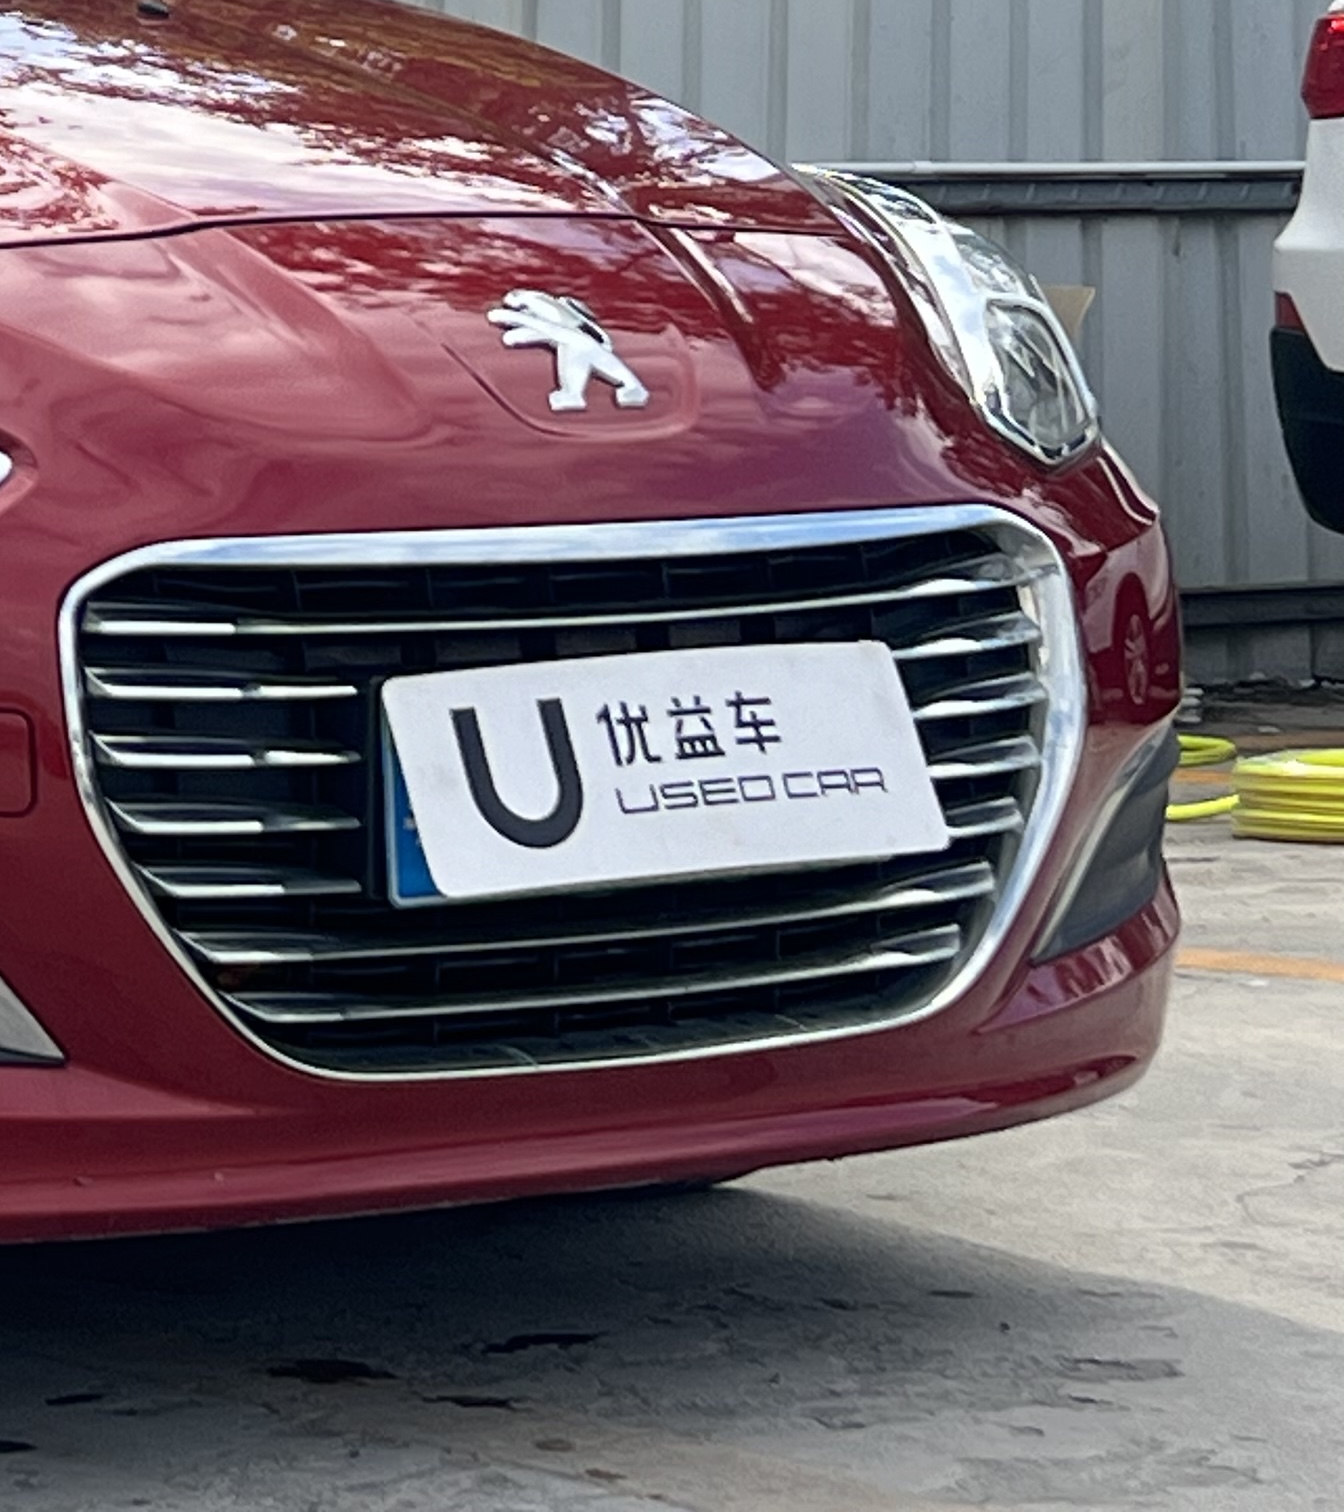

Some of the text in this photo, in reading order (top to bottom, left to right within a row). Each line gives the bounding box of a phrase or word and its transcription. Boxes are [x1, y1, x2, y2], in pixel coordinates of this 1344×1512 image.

[596, 691, 783, 767] 优益车
[449, 697, 584, 850] U
[615, 767, 889, 814] USED CAR
